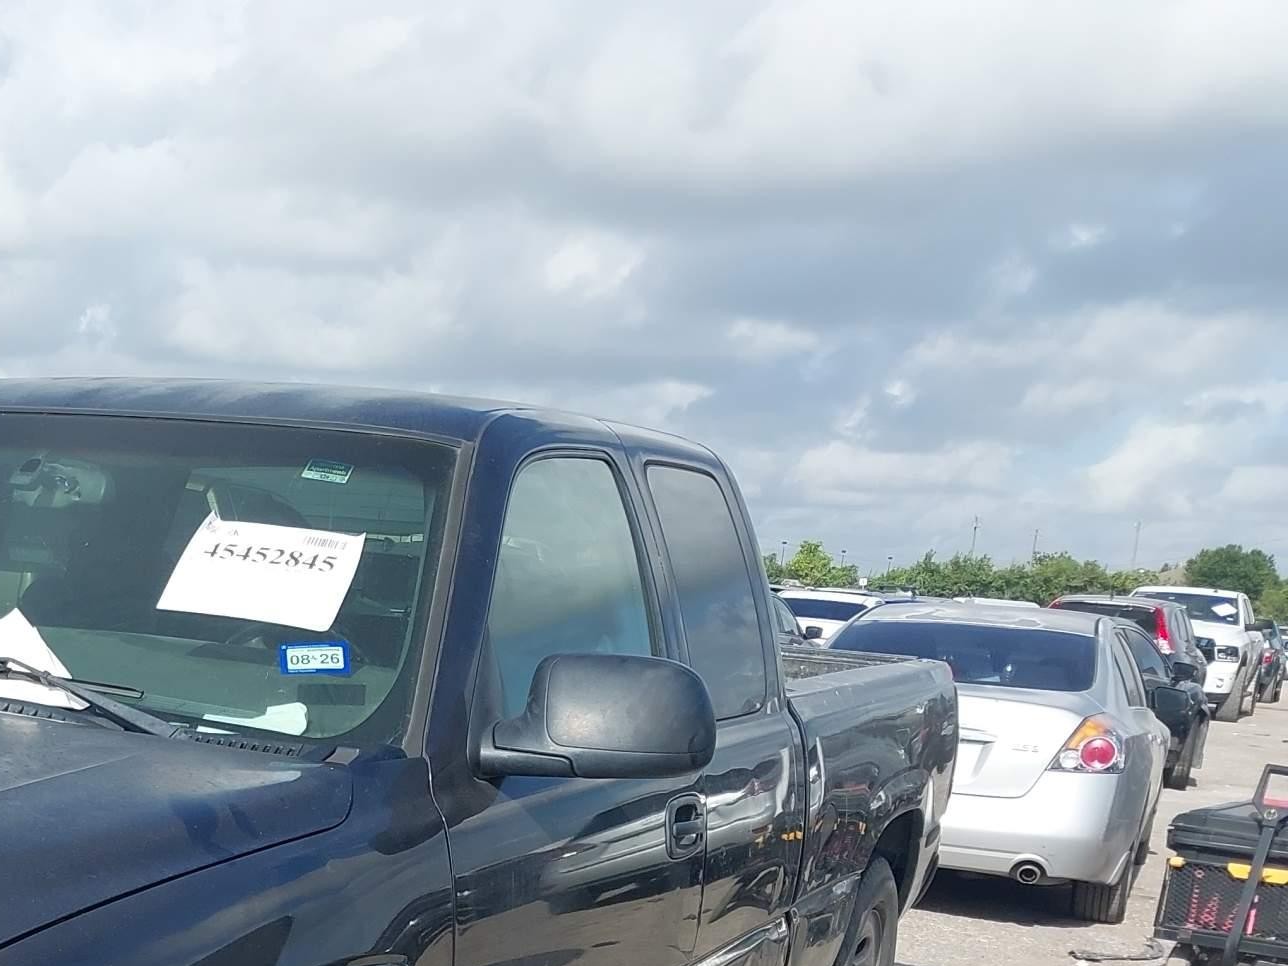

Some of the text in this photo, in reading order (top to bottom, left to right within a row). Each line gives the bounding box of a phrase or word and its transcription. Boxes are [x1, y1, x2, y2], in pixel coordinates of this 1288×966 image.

[203, 542, 338, 572] 45452845
[290, 653, 340, 666] 08 26
